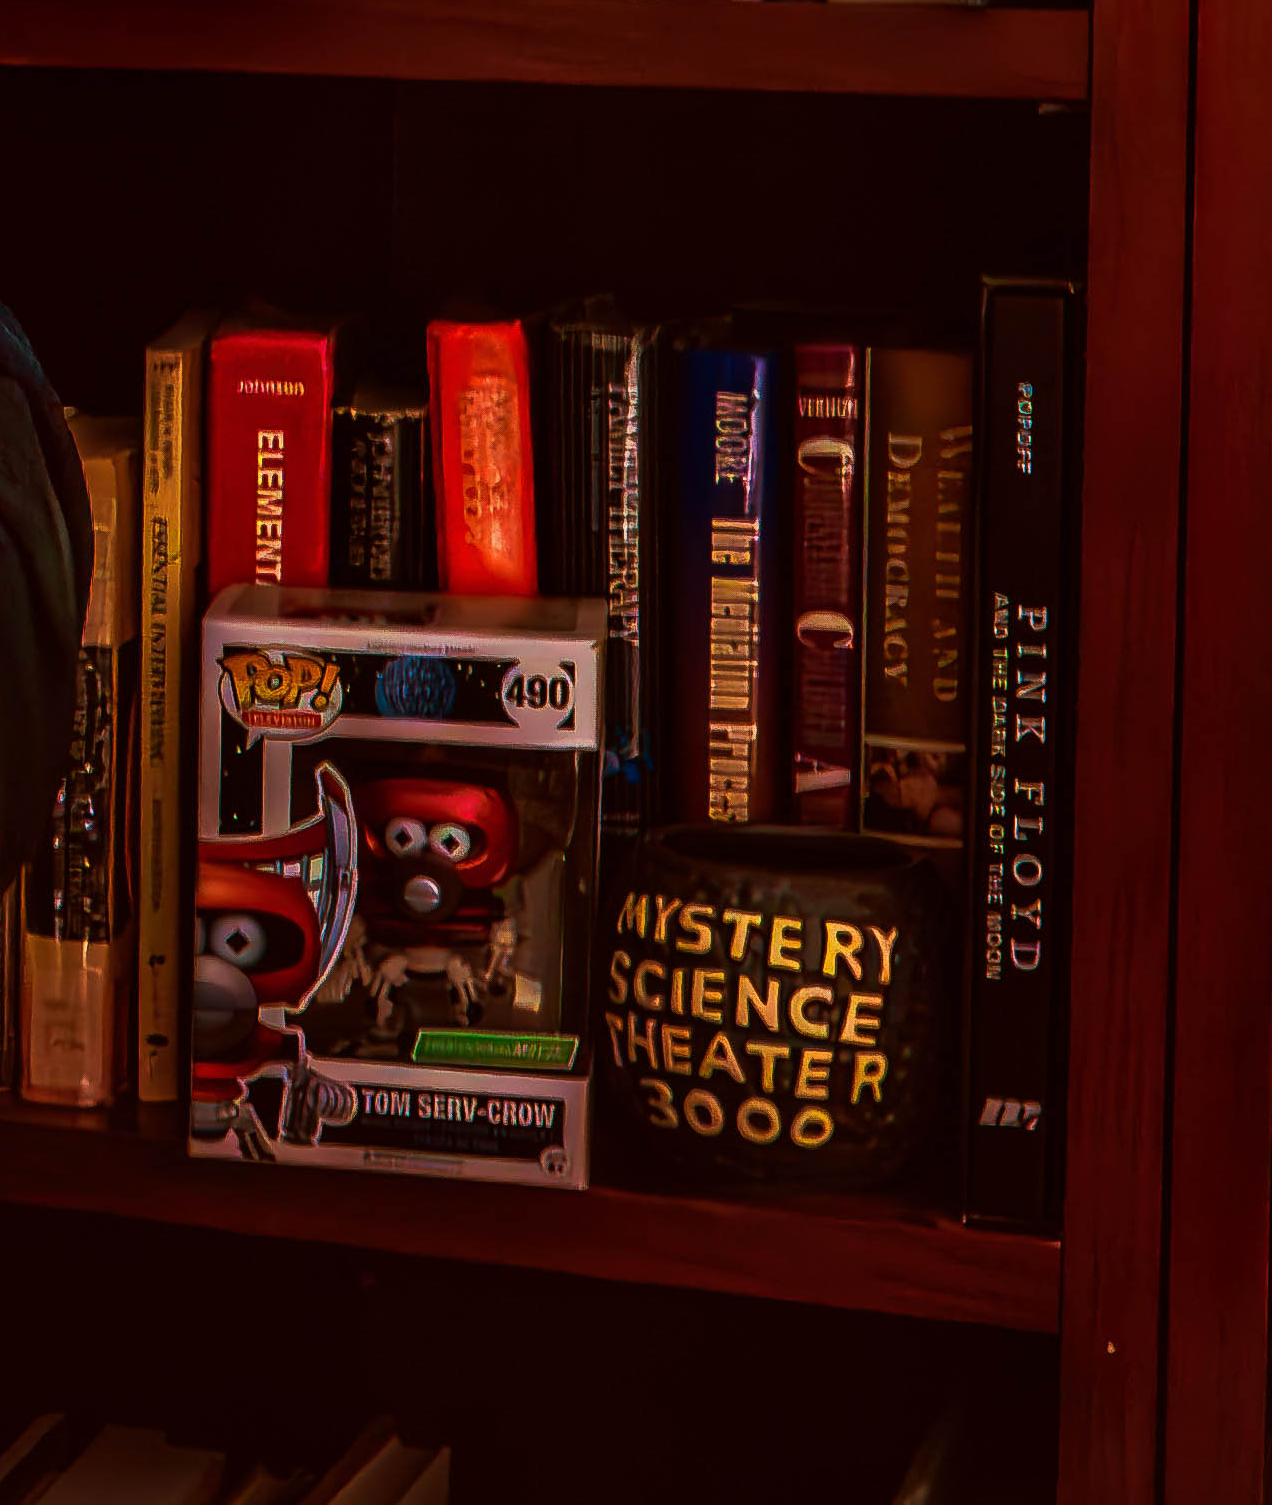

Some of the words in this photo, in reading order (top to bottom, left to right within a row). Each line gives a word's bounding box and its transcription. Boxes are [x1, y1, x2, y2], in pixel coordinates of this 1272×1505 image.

[236, 378, 305, 397] Johnson
[715, 390, 751, 485] MOORE
[1017, 381, 1034, 475] POPOFF
[711, 517, 759, 565] The
[935, 424, 974, 600] WEALTH
[149, 517, 170, 615] ESSENTIAL
[607, 495, 641, 648] THERAPY
[883, 431, 924, 687] DEMOCRACY
[992, 592, 1009, 641] AND
[219, 650, 342, 713] POP!
[505, 674, 572, 711] 490
[930, 618, 960, 703] AND
[991, 646, 1008, 691] THE
[1013, 603, 1049, 746] PINK
[990, 695, 1008, 758] DARK
[708, 720, 759, 824] Process
[989, 764, 1007, 816] SIDE
[988, 823, 1006, 854] OF
[1011, 778, 1045, 975] FLOYD
[987, 861, 1005, 905] THE
[615, 890, 900, 986] MYSTERY
[985, 910, 1004, 982] MOON
[606, 949, 885, 1047] SCIENCE
[603, 1010, 890, 1106] THEATER
[362, 1088, 412, 1119] TOM
[418, 1093, 557, 1130] SERV-CROW
[638, 1077, 835, 1150] 3000
